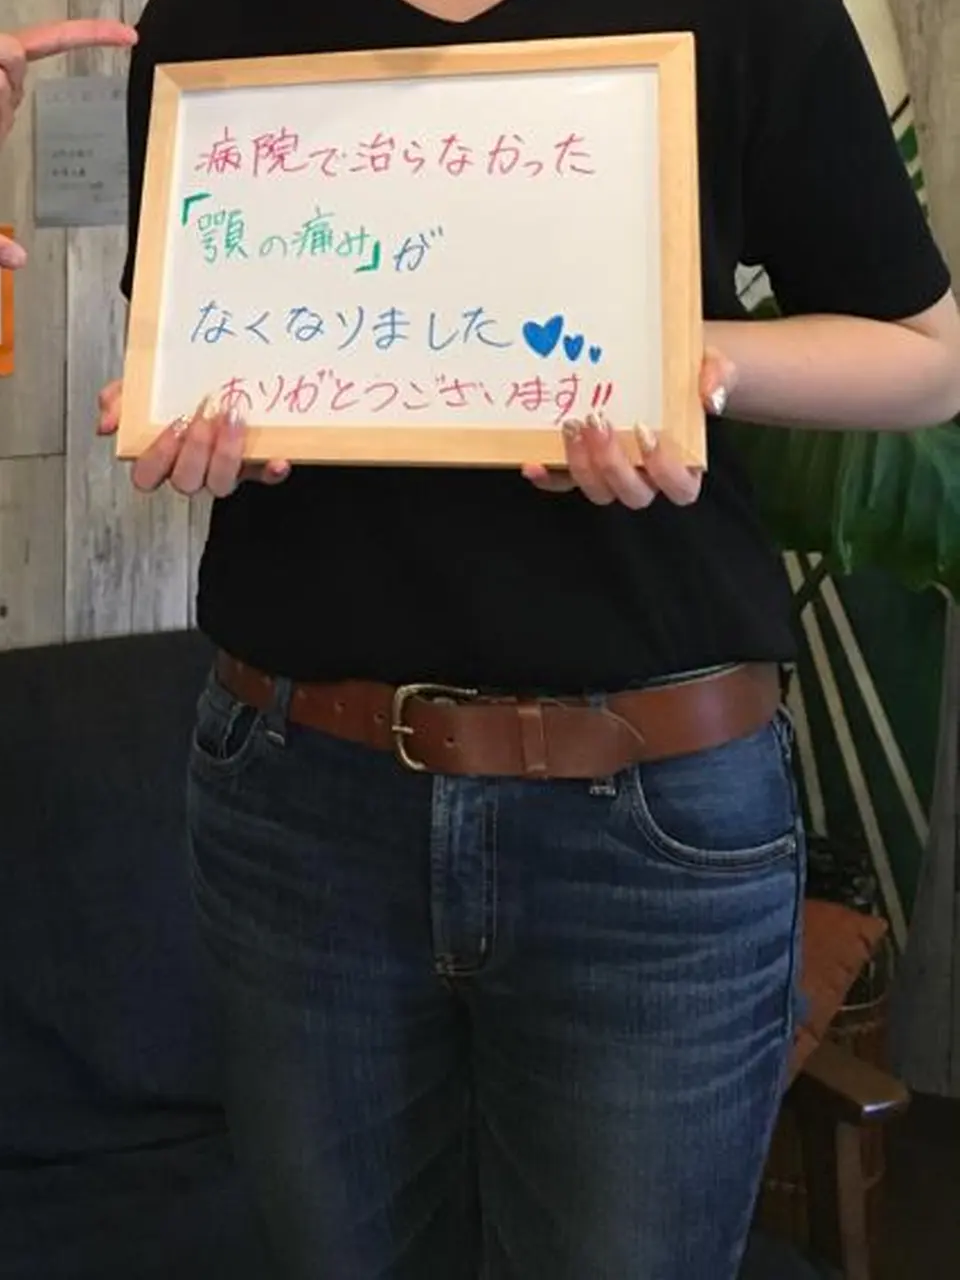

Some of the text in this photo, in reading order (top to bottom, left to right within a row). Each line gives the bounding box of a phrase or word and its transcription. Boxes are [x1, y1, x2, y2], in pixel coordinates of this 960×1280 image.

[193, 126, 597, 179] 病院で治らなかった
[191, 299, 513, 352] なくなりました
